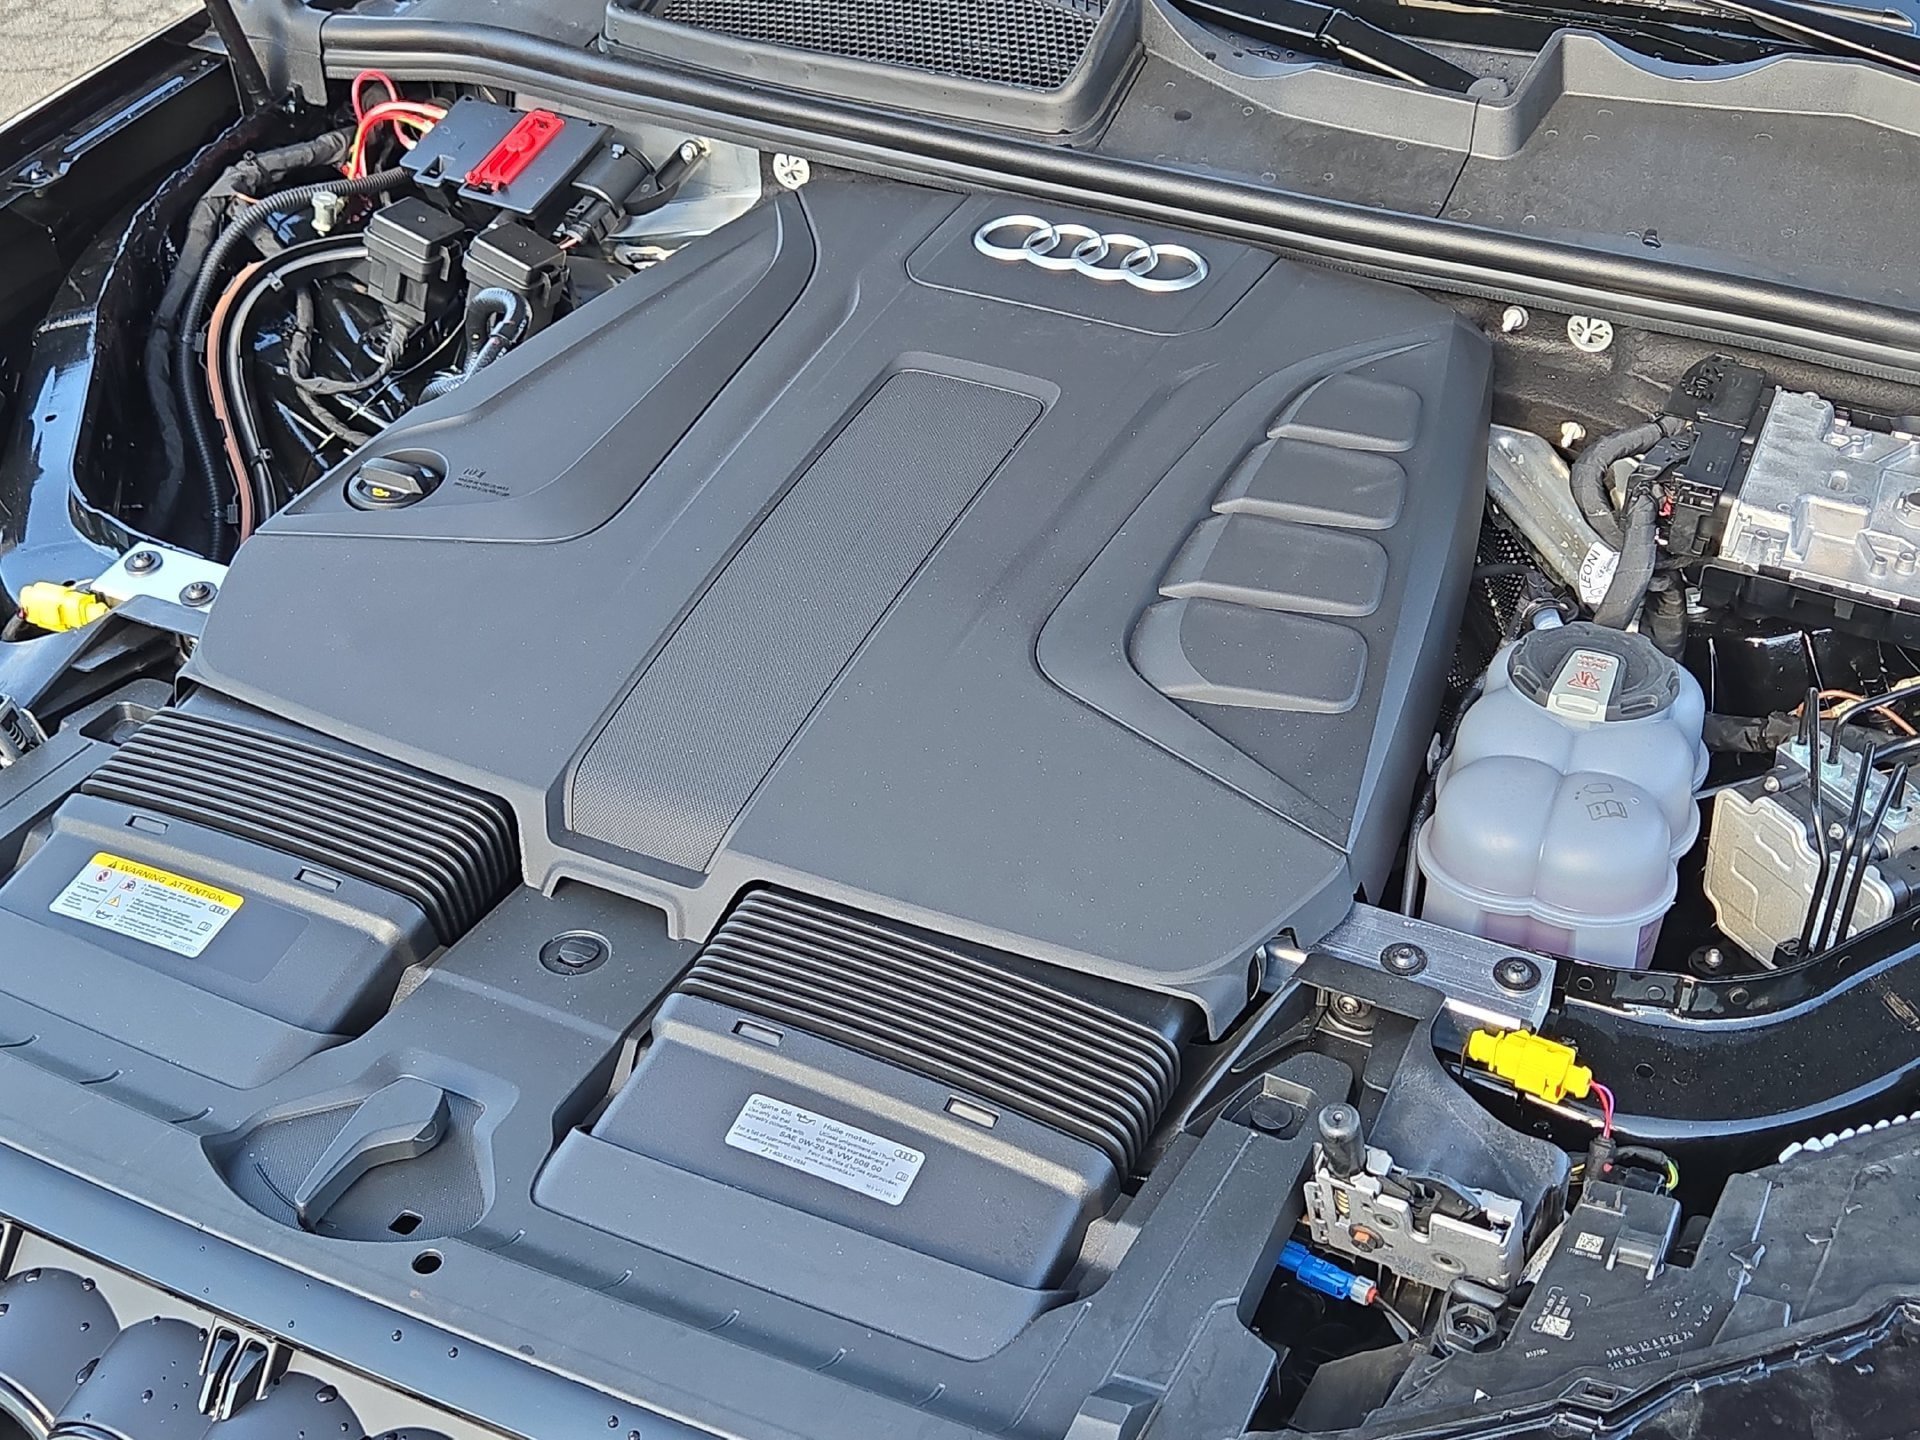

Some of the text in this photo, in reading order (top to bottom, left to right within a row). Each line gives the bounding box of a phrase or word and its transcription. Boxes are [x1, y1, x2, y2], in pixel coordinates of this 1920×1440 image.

[1581, 550, 1600, 588] LEONI
[120, 864, 166, 883] WARNING
[169, 880, 225, 903] ATTENTION
[751, 1098, 792, 1116] Engine Oil
[778, 1131, 797, 1141] SAE
[797, 1138, 825, 1151] 0W-20
[835, 1151, 852, 1161] VW
[853, 1158, 869, 1167] 508
[870, 1164, 882, 1172] 00
[822, 1123, 876, 1146] Huile moteur
